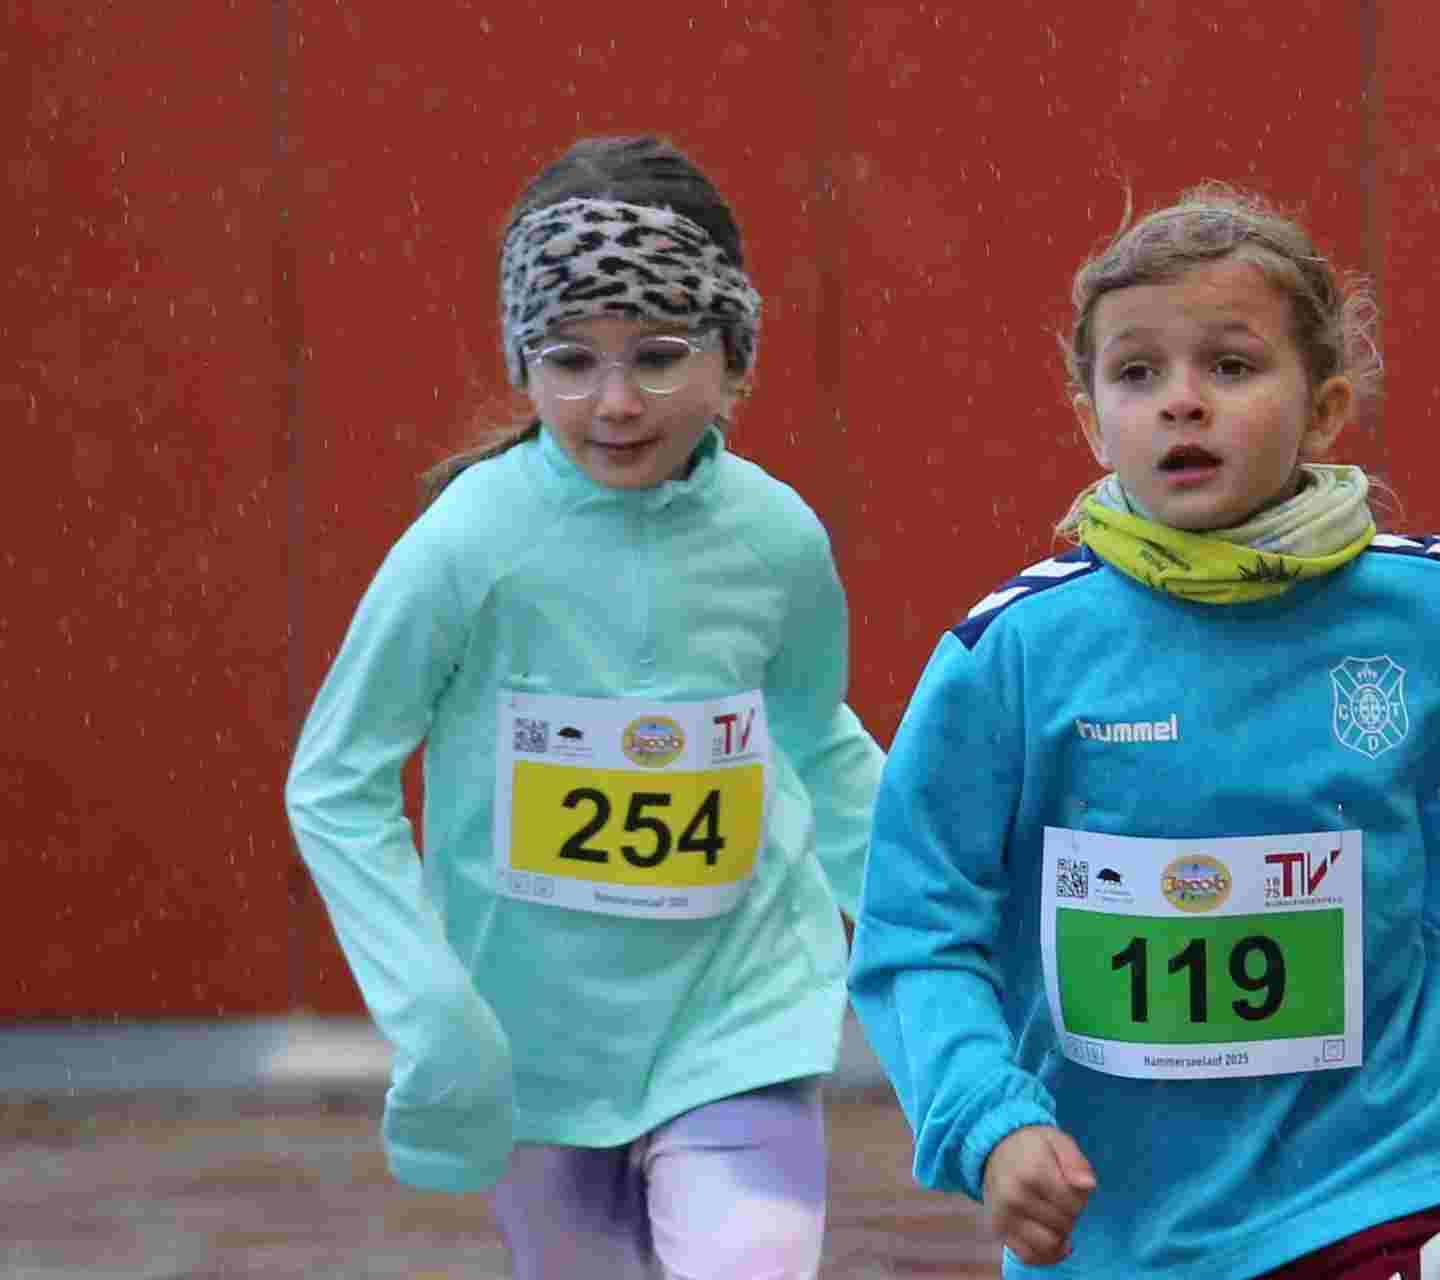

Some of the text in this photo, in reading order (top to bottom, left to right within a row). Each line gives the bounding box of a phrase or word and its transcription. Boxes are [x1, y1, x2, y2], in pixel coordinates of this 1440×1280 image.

[1075, 712, 1178, 743] hummel
[557, 786, 726, 869] 254
[1111, 935, 1287, 1024] 119
